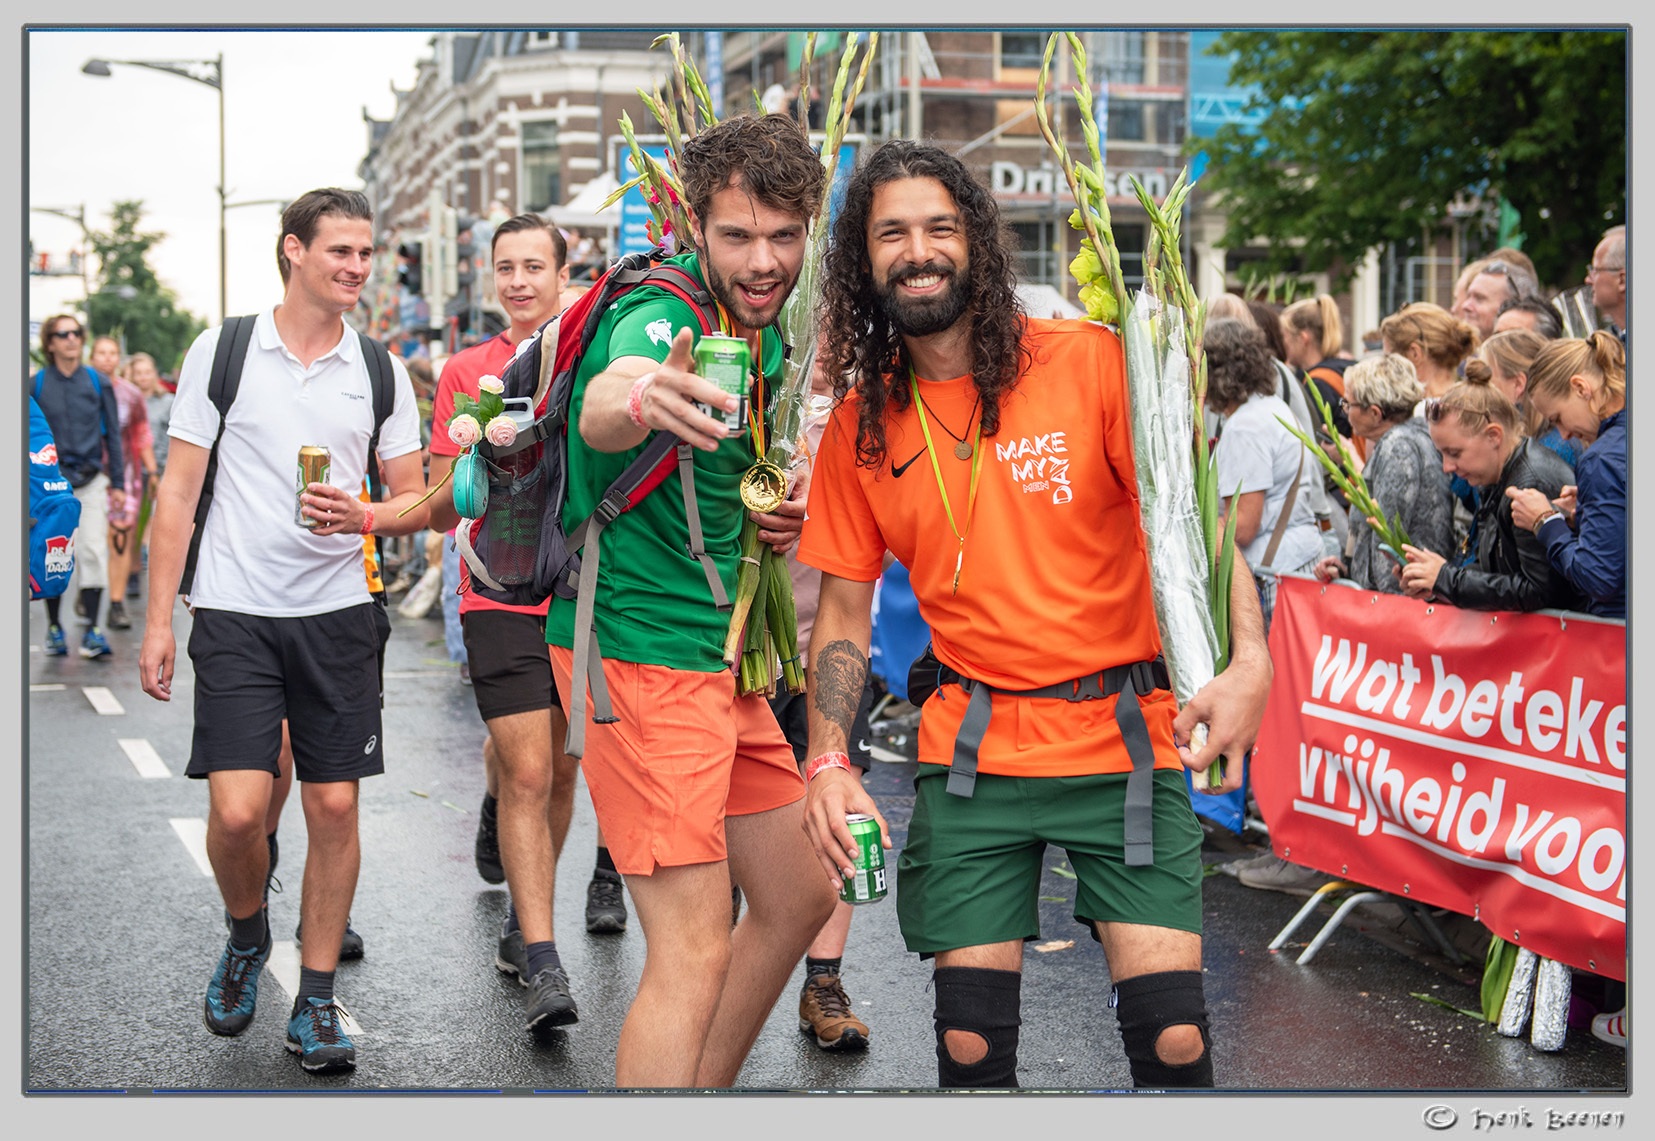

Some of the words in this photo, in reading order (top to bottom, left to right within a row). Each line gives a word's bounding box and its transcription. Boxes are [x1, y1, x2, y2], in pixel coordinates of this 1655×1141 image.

[991, 160, 1167, 198] Drisen
[995, 432, 1068, 462] MAKE
[1012, 457, 1048, 482] MY
[1048, 455, 1073, 505] DAY
[1311, 634, 1421, 721] Wat
[1420, 654, 1626, 770] beteke
[1299, 734, 1506, 853] vrijheid
[1505, 803, 1626, 901] voo
